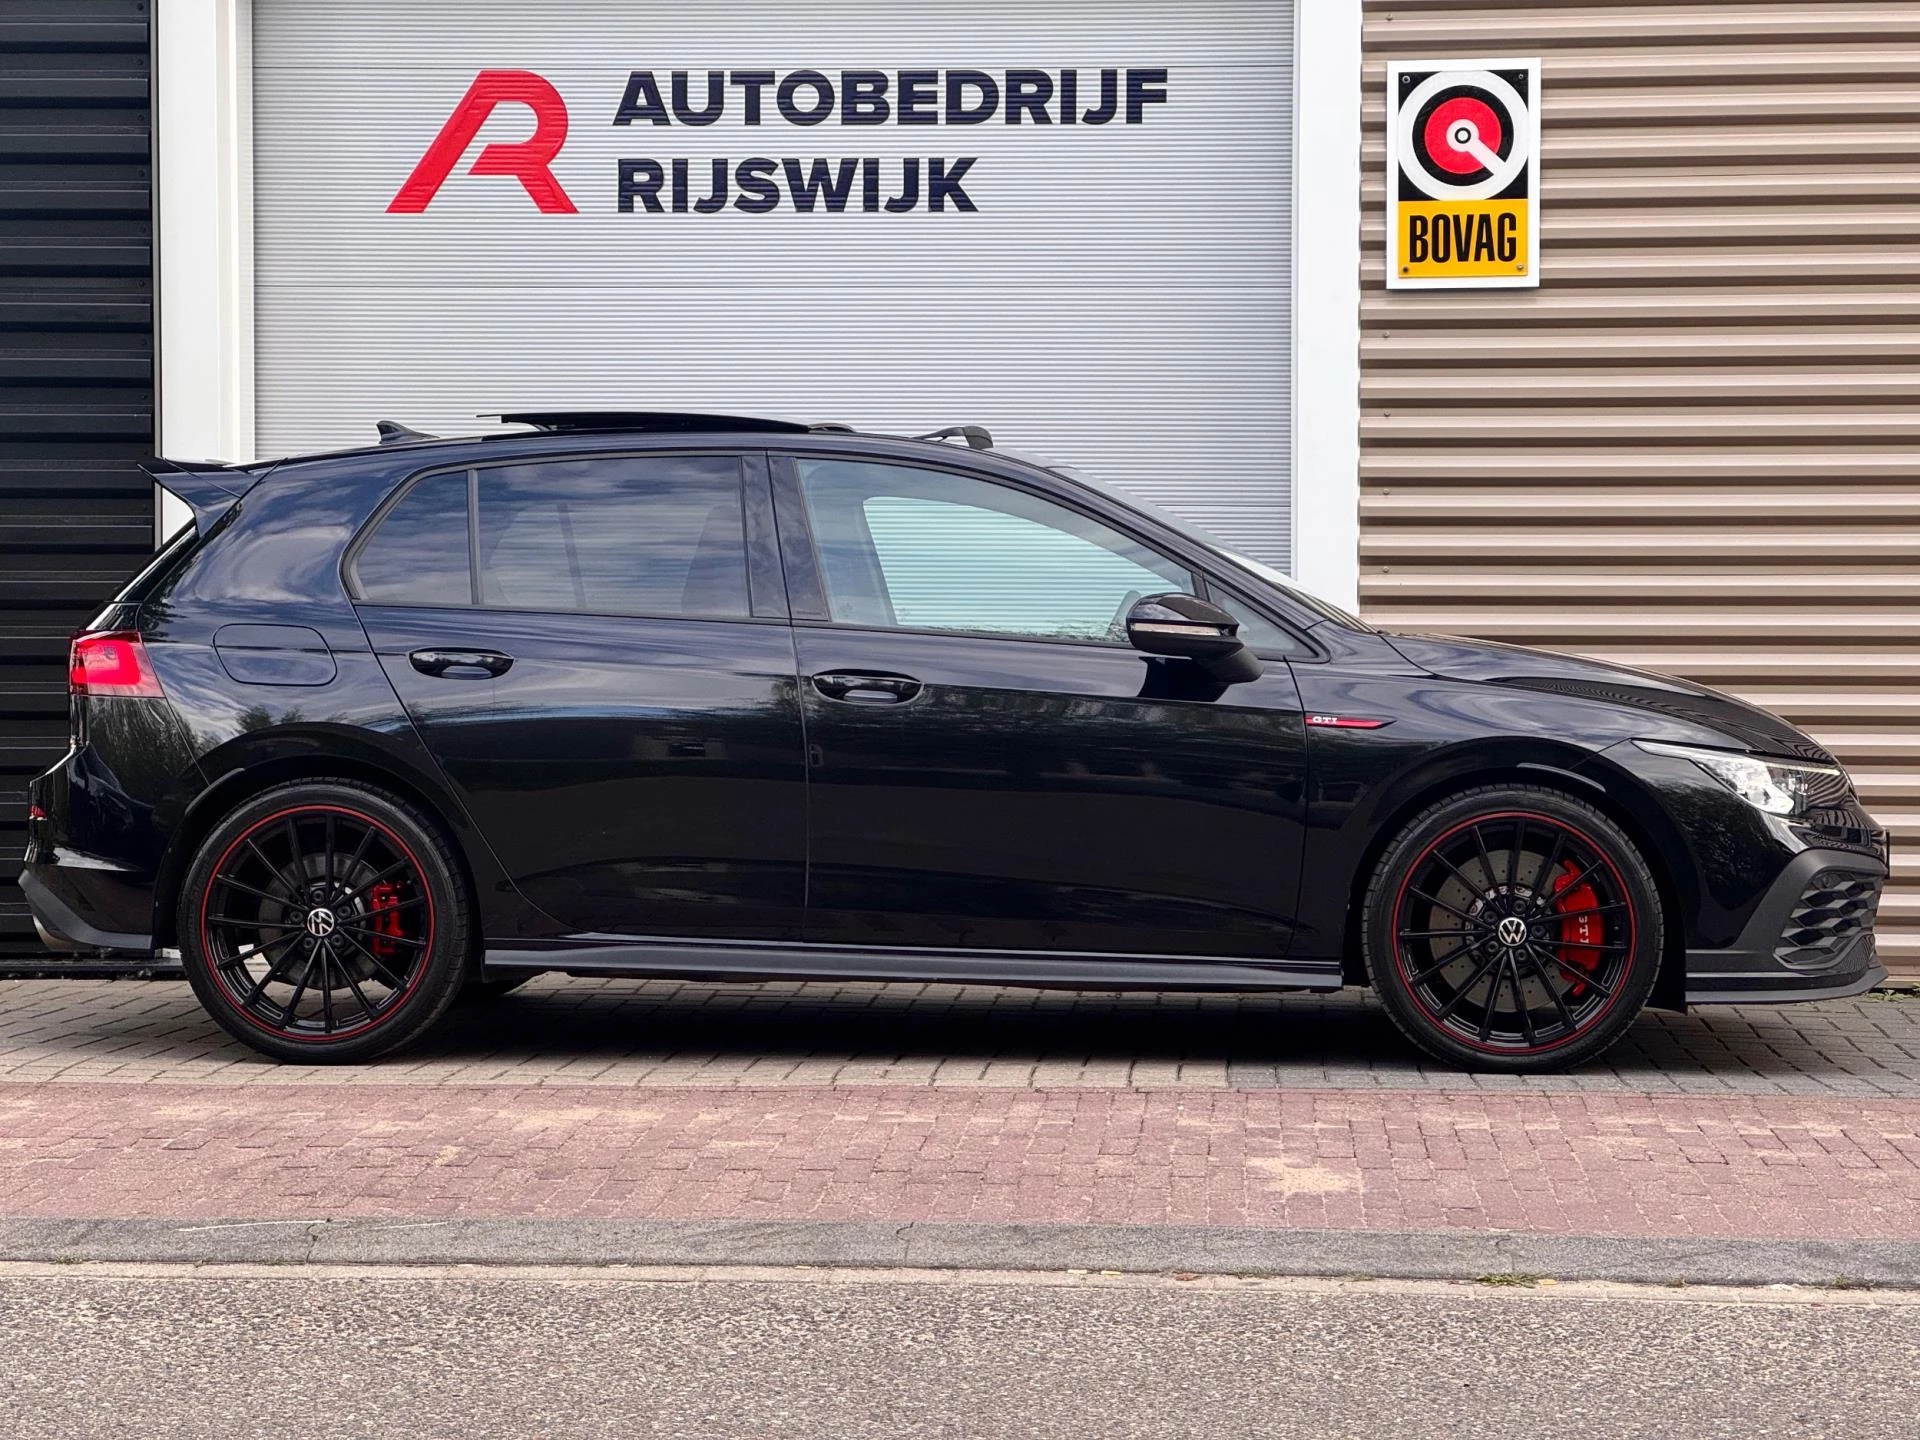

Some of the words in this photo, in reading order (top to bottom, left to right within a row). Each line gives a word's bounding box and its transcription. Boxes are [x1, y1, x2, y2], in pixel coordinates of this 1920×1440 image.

[613, 69, 1168, 127] AUTOBEDRIJF
[617, 157, 978, 214] RIJSWIJK
[1409, 212, 1517, 264] BOVAG
[1312, 716, 1338, 724] GTI
